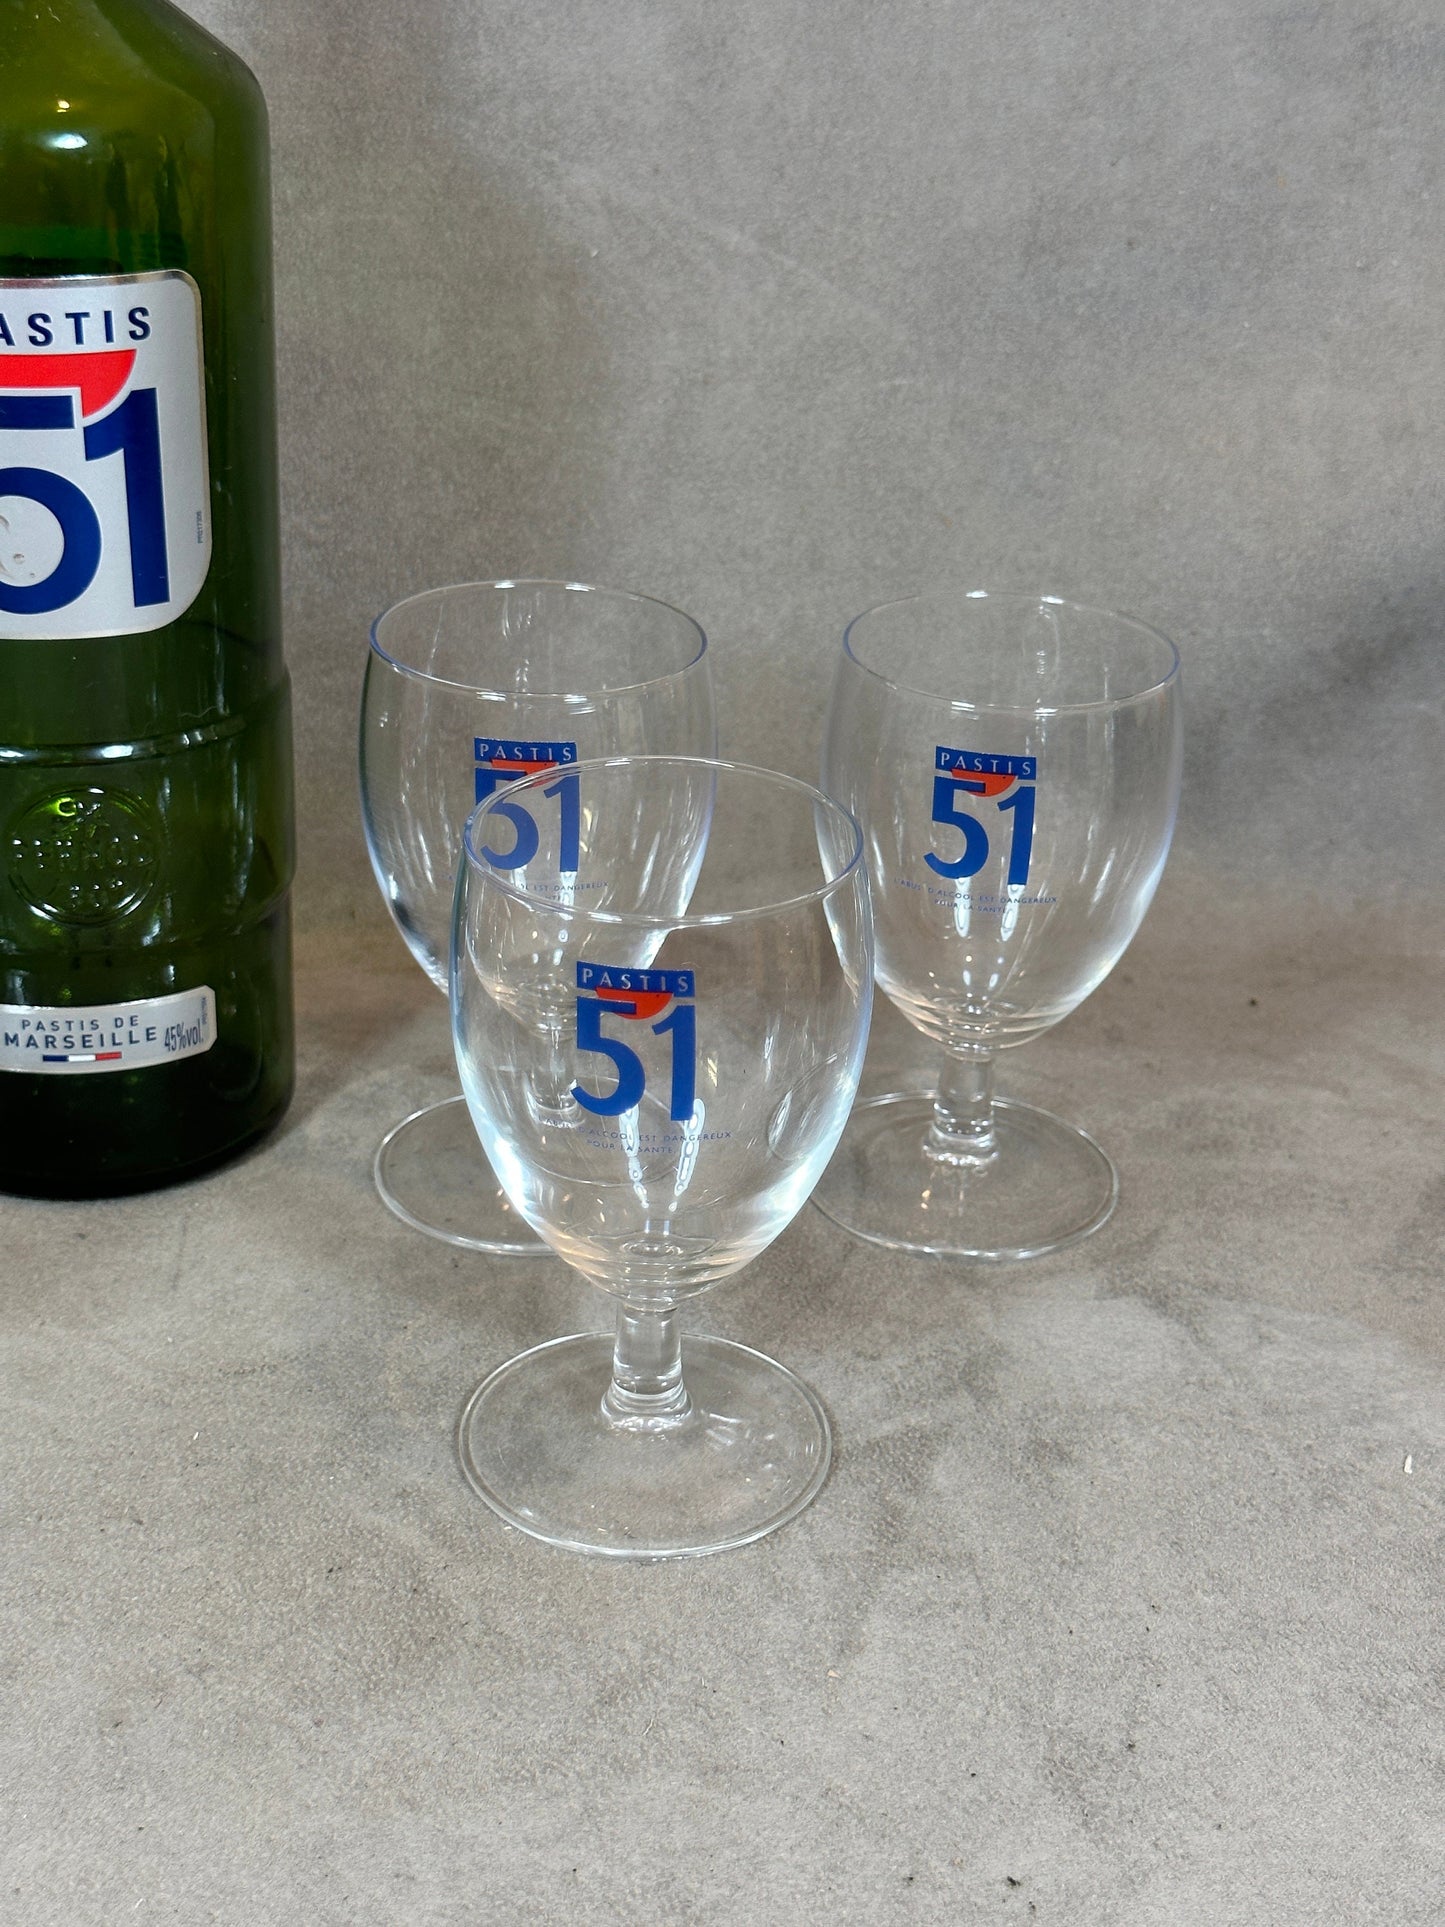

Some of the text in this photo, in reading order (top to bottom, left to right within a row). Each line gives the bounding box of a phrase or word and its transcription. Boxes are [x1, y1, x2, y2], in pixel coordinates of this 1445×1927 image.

[480, 743, 572, 761] PASTIS
[941, 752, 1031, 776] PASTIS
[474, 767, 580, 871] 51
[923, 775, 1036, 886] 51
[582, 968, 689, 992] PASTIS
[21, 1014, 139, 1032] PASTIS DE
[4, 1026, 158, 1049] MARSEILLE
[570, 996, 696, 1121] 51
[639, 1134, 656, 1142] EST
[663, 1131, 732, 1142] DANGEREUX
